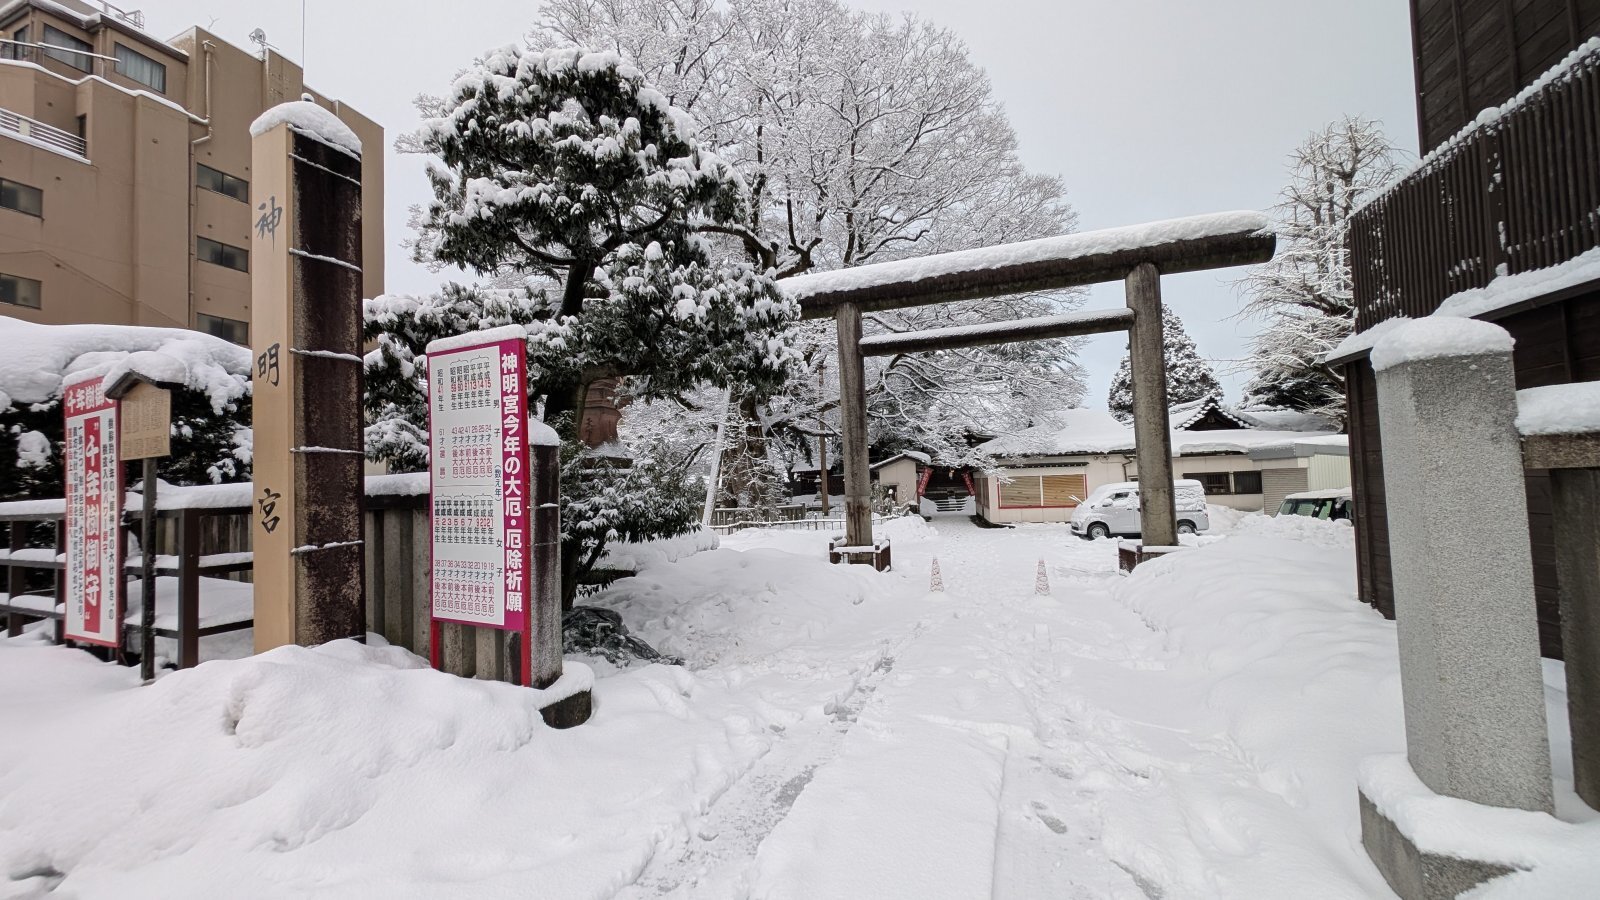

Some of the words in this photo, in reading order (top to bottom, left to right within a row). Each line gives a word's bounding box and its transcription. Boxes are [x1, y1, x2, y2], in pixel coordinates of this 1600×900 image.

[67, 383, 113, 413] 千年樹御
[255, 196, 282, 534] 神明宮
[502, 352, 523, 612] 神明宮今年の大厄・厄除祈願
